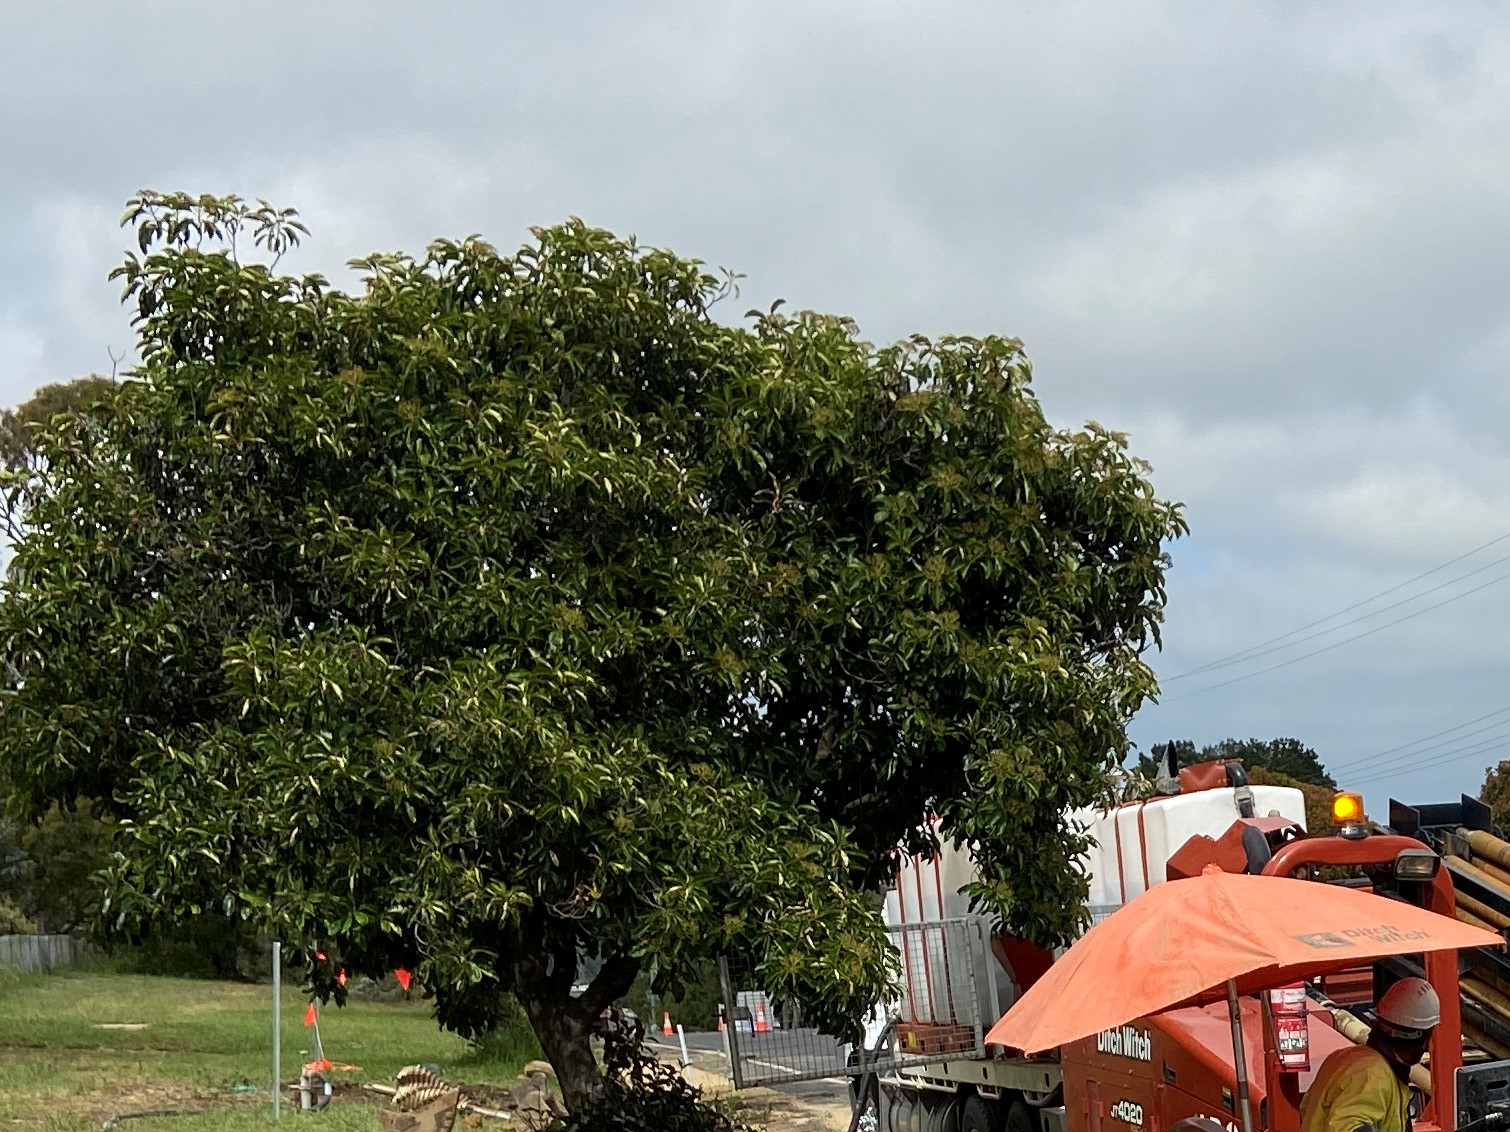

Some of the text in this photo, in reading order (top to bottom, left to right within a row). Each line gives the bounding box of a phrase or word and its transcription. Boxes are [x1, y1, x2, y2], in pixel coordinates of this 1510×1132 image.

[1341, 924, 1400, 938] Ditch
[1369, 929, 1431, 943] Witch
[1122, 1026, 1151, 1061] Witch
